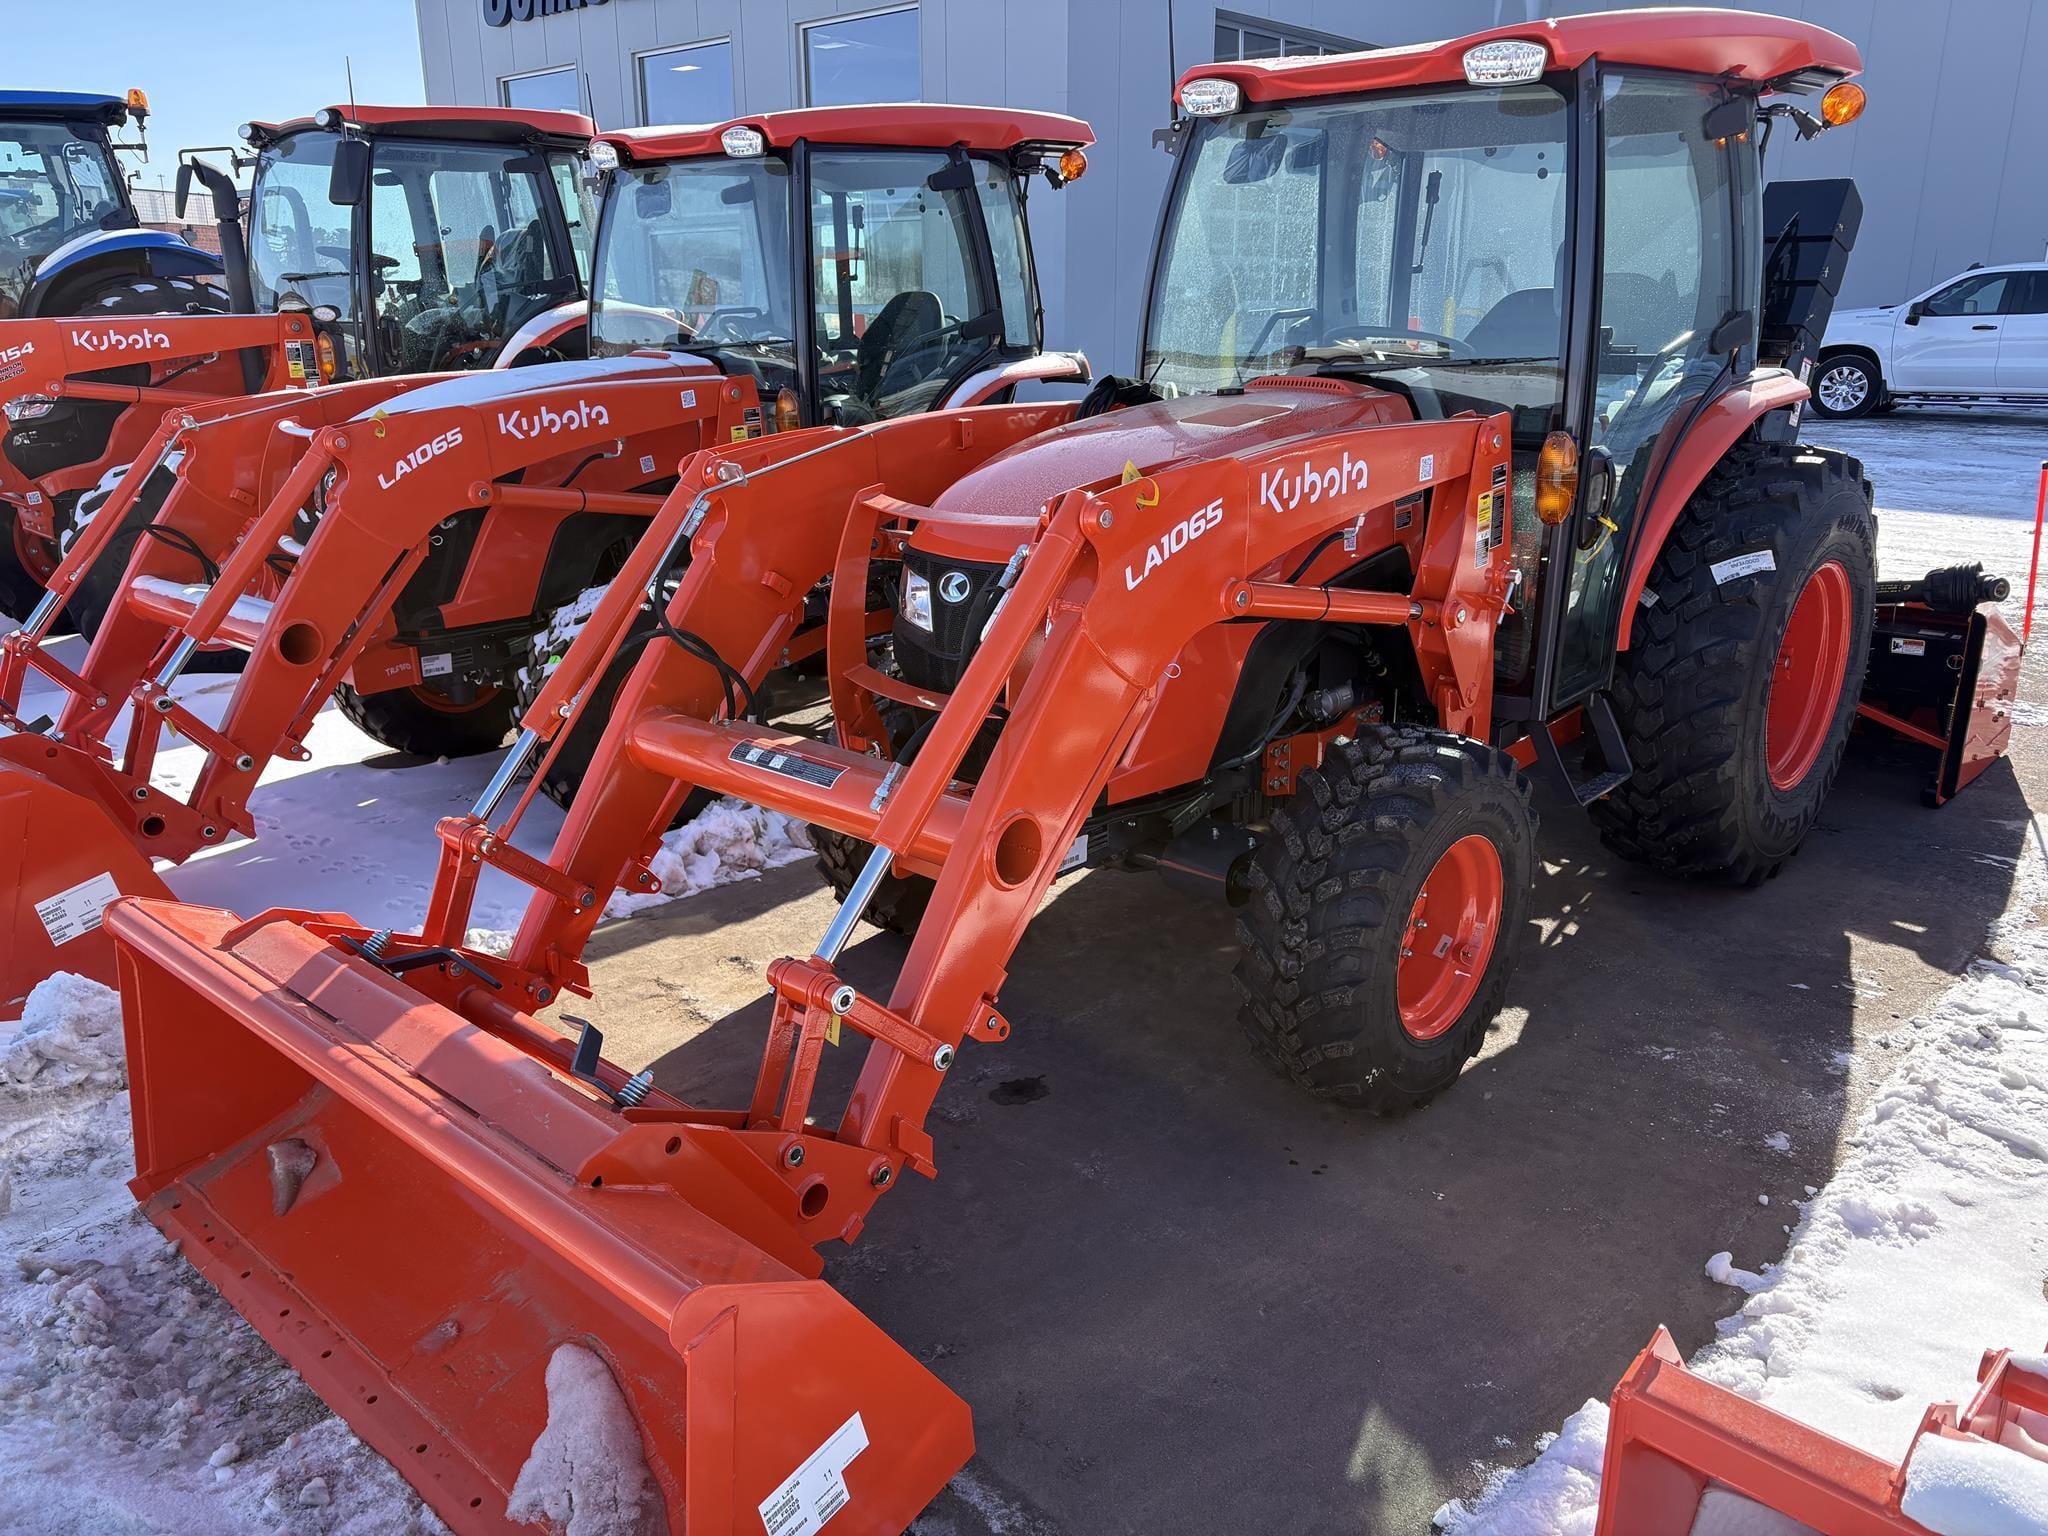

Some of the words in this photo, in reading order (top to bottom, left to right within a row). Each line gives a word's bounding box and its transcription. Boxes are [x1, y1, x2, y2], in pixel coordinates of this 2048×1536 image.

[0, 341, 35, 363] 154
[72, 328, 170, 351] Kubota
[498, 400, 609, 439] Kubota
[377, 427, 463, 490] LA1065
[1261, 452, 1368, 512] Kubota
[1125, 497, 1223, 591] LA1065
